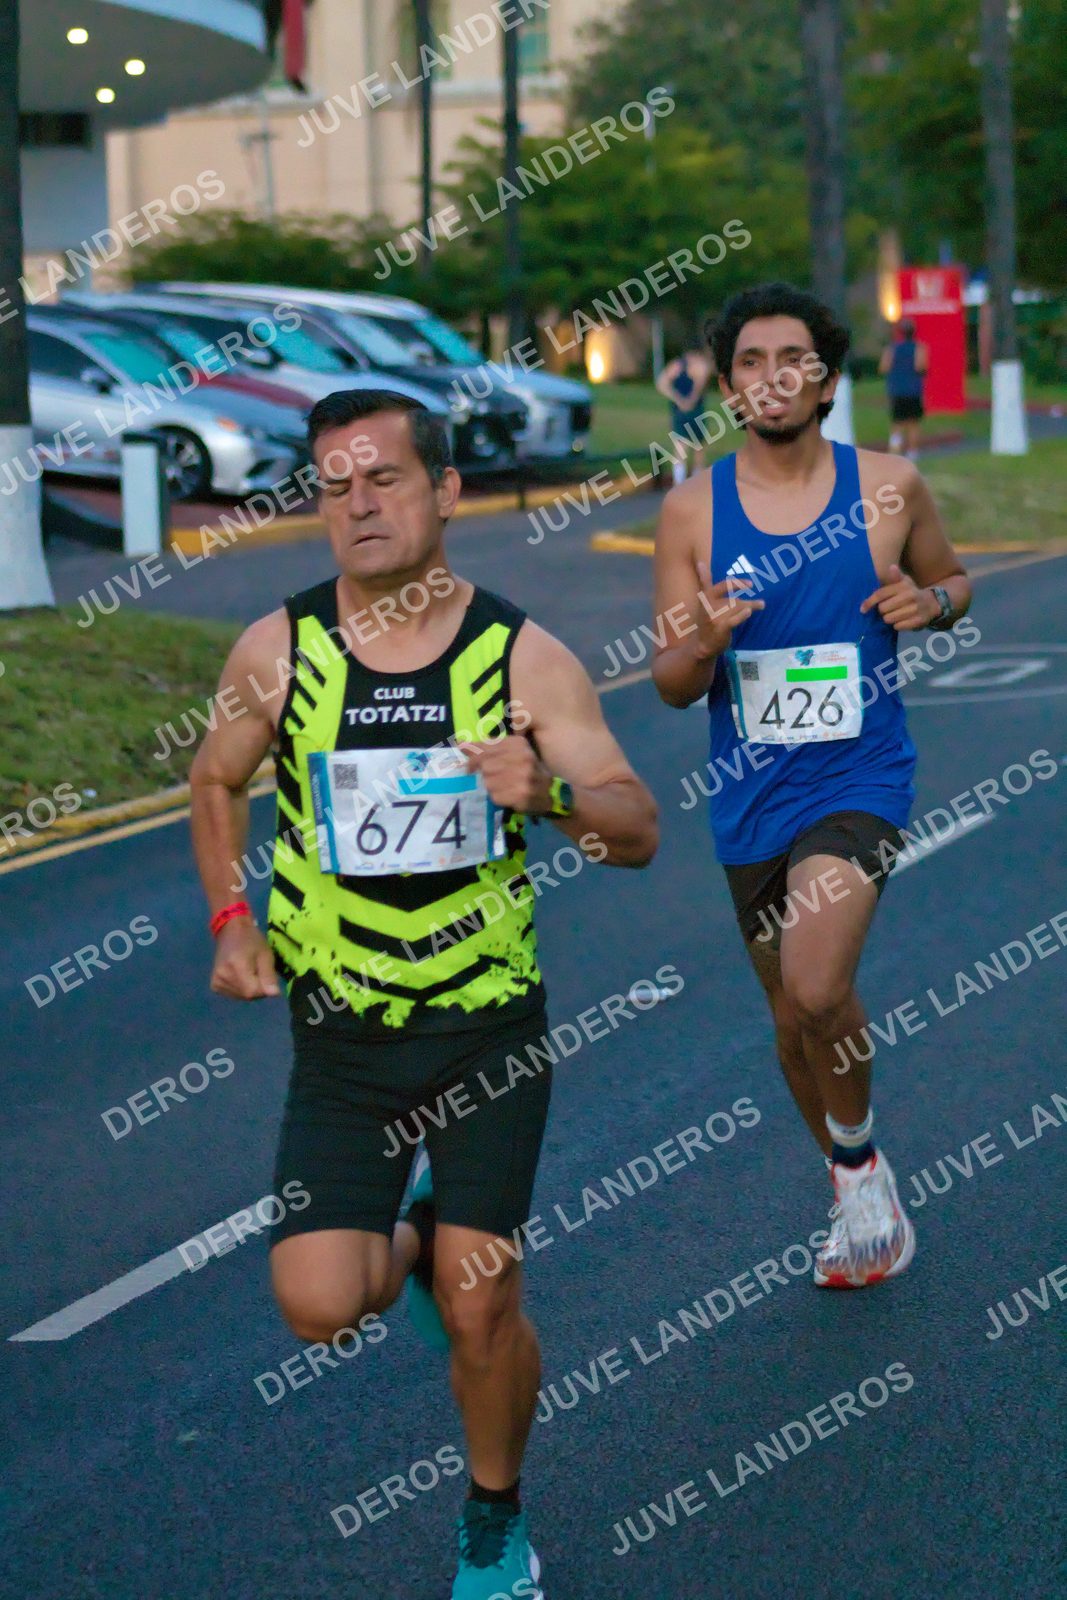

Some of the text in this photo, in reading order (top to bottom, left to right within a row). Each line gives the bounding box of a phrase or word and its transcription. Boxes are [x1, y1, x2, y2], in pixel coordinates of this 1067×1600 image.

[373, 686, 416, 700] CLUB
[759, 685, 843, 730] 426
[345, 705, 446, 726] TOTATZI
[356, 799, 467, 856] 674
